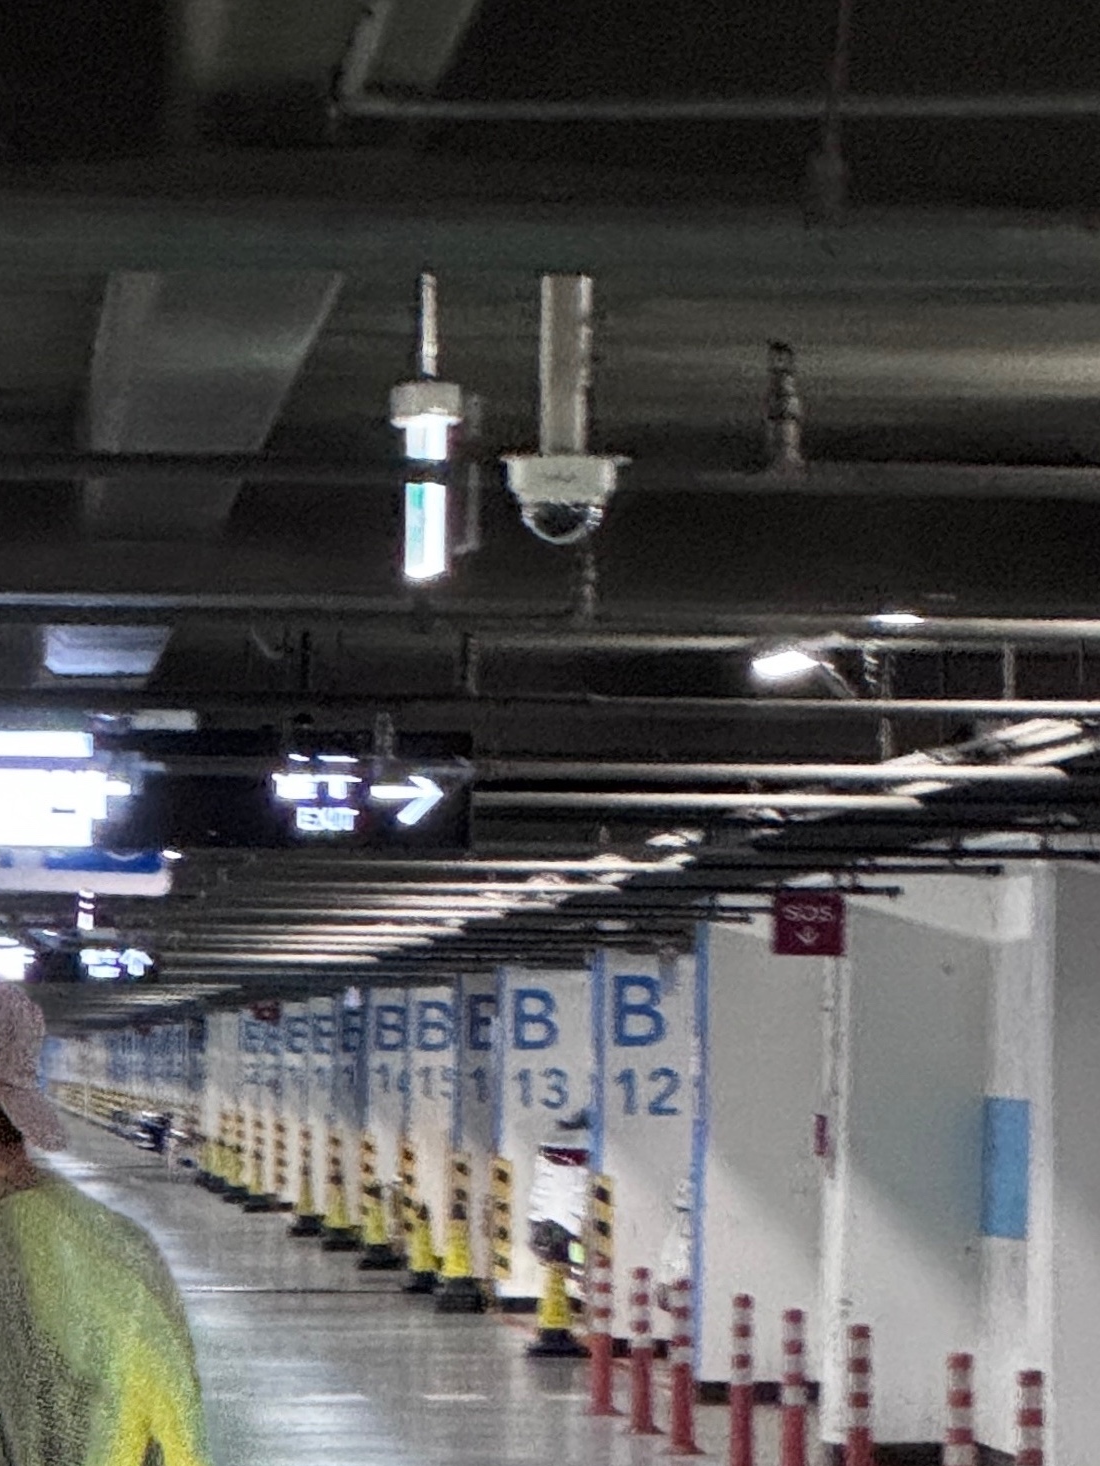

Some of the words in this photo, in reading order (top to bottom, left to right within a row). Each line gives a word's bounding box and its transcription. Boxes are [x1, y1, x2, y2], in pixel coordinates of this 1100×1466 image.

[782, 904, 835, 920] SOS
[375, 1005, 407, 1051] B
[418, 1001, 455, 1051] B
[514, 988, 560, 1050] B
[613, 973, 668, 1048] B
[514, 1067, 568, 1109] 13
[615, 1066, 682, 1116] 12
